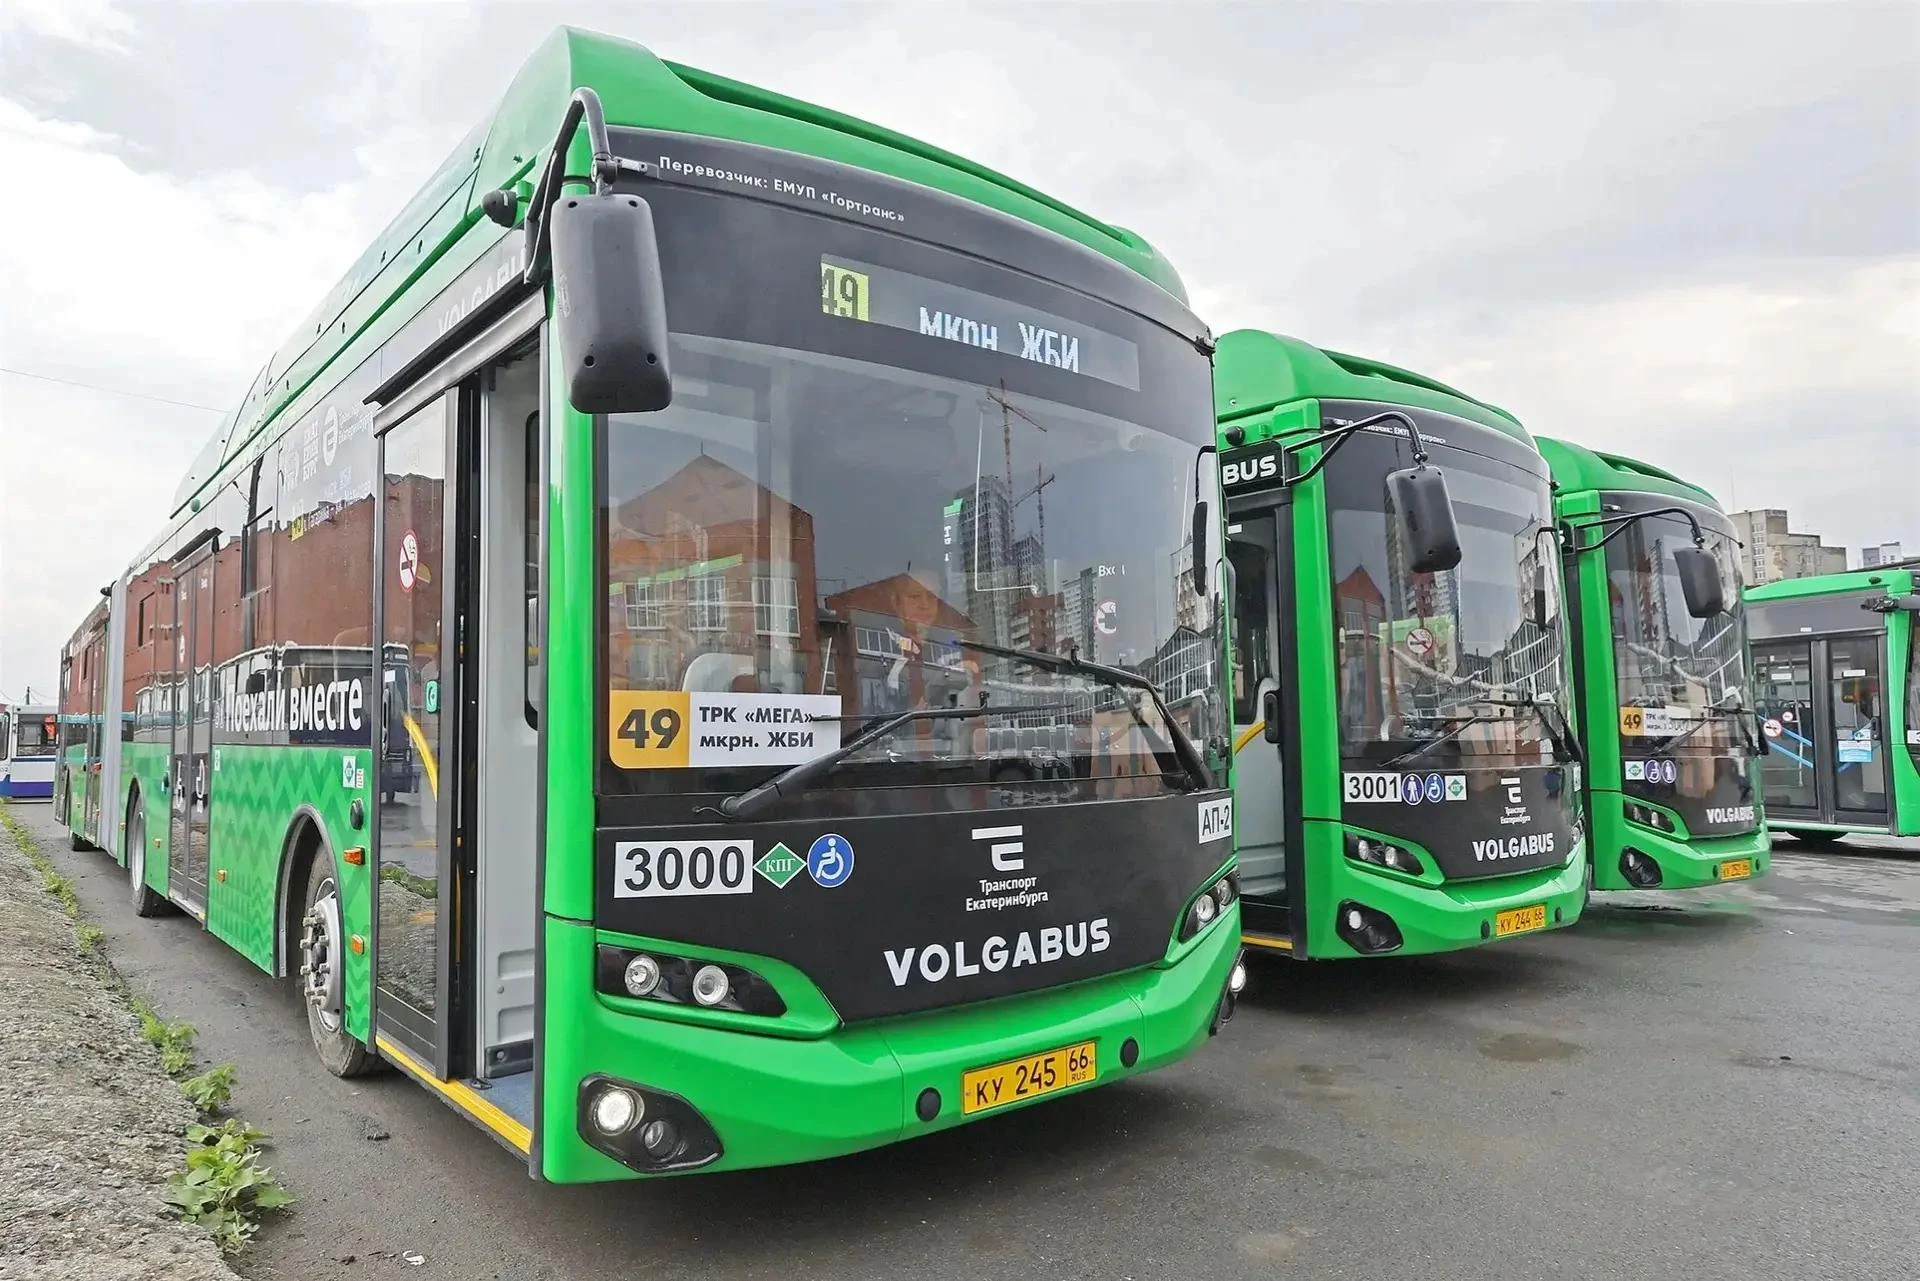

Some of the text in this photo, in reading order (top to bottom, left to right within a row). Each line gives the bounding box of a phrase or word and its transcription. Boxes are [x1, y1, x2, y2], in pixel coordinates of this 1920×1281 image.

[660, 156, 905, 222] Перевозчик: ЕМУП «Гортранс»
[821, 267, 859, 318] 49
[1018, 321, 1080, 374] ЖБИ
[1222, 455, 1277, 486] BUS
[226, 678, 363, 732] Поехали вместе
[699, 706, 813, 724] ТРК «МЕГА»
[617, 708, 682, 749] 49
[1623, 713, 1642, 729] 49
[700, 731, 814, 751] мкрн. ЖБИ
[1349, 776, 1398, 799] 3001
[1202, 805, 1230, 836] АП-2
[1706, 806, 1755, 823] VOLGABUS
[1472, 832, 1555, 862] VOLGABUS
[624, 845, 745, 891] 3000
[765, 858, 796, 874] КПГ
[965, 890, 1049, 911] Екатеринбурга
[979, 876, 1037, 896] Транспорт
[1515, 911, 1531, 930] 244
[883, 917, 1111, 987] VOLGABUS
[1015, 1056, 1056, 1095] 245
[1068, 1047, 1089, 1072] 66
[1071, 1071, 1087, 1082] RUS
